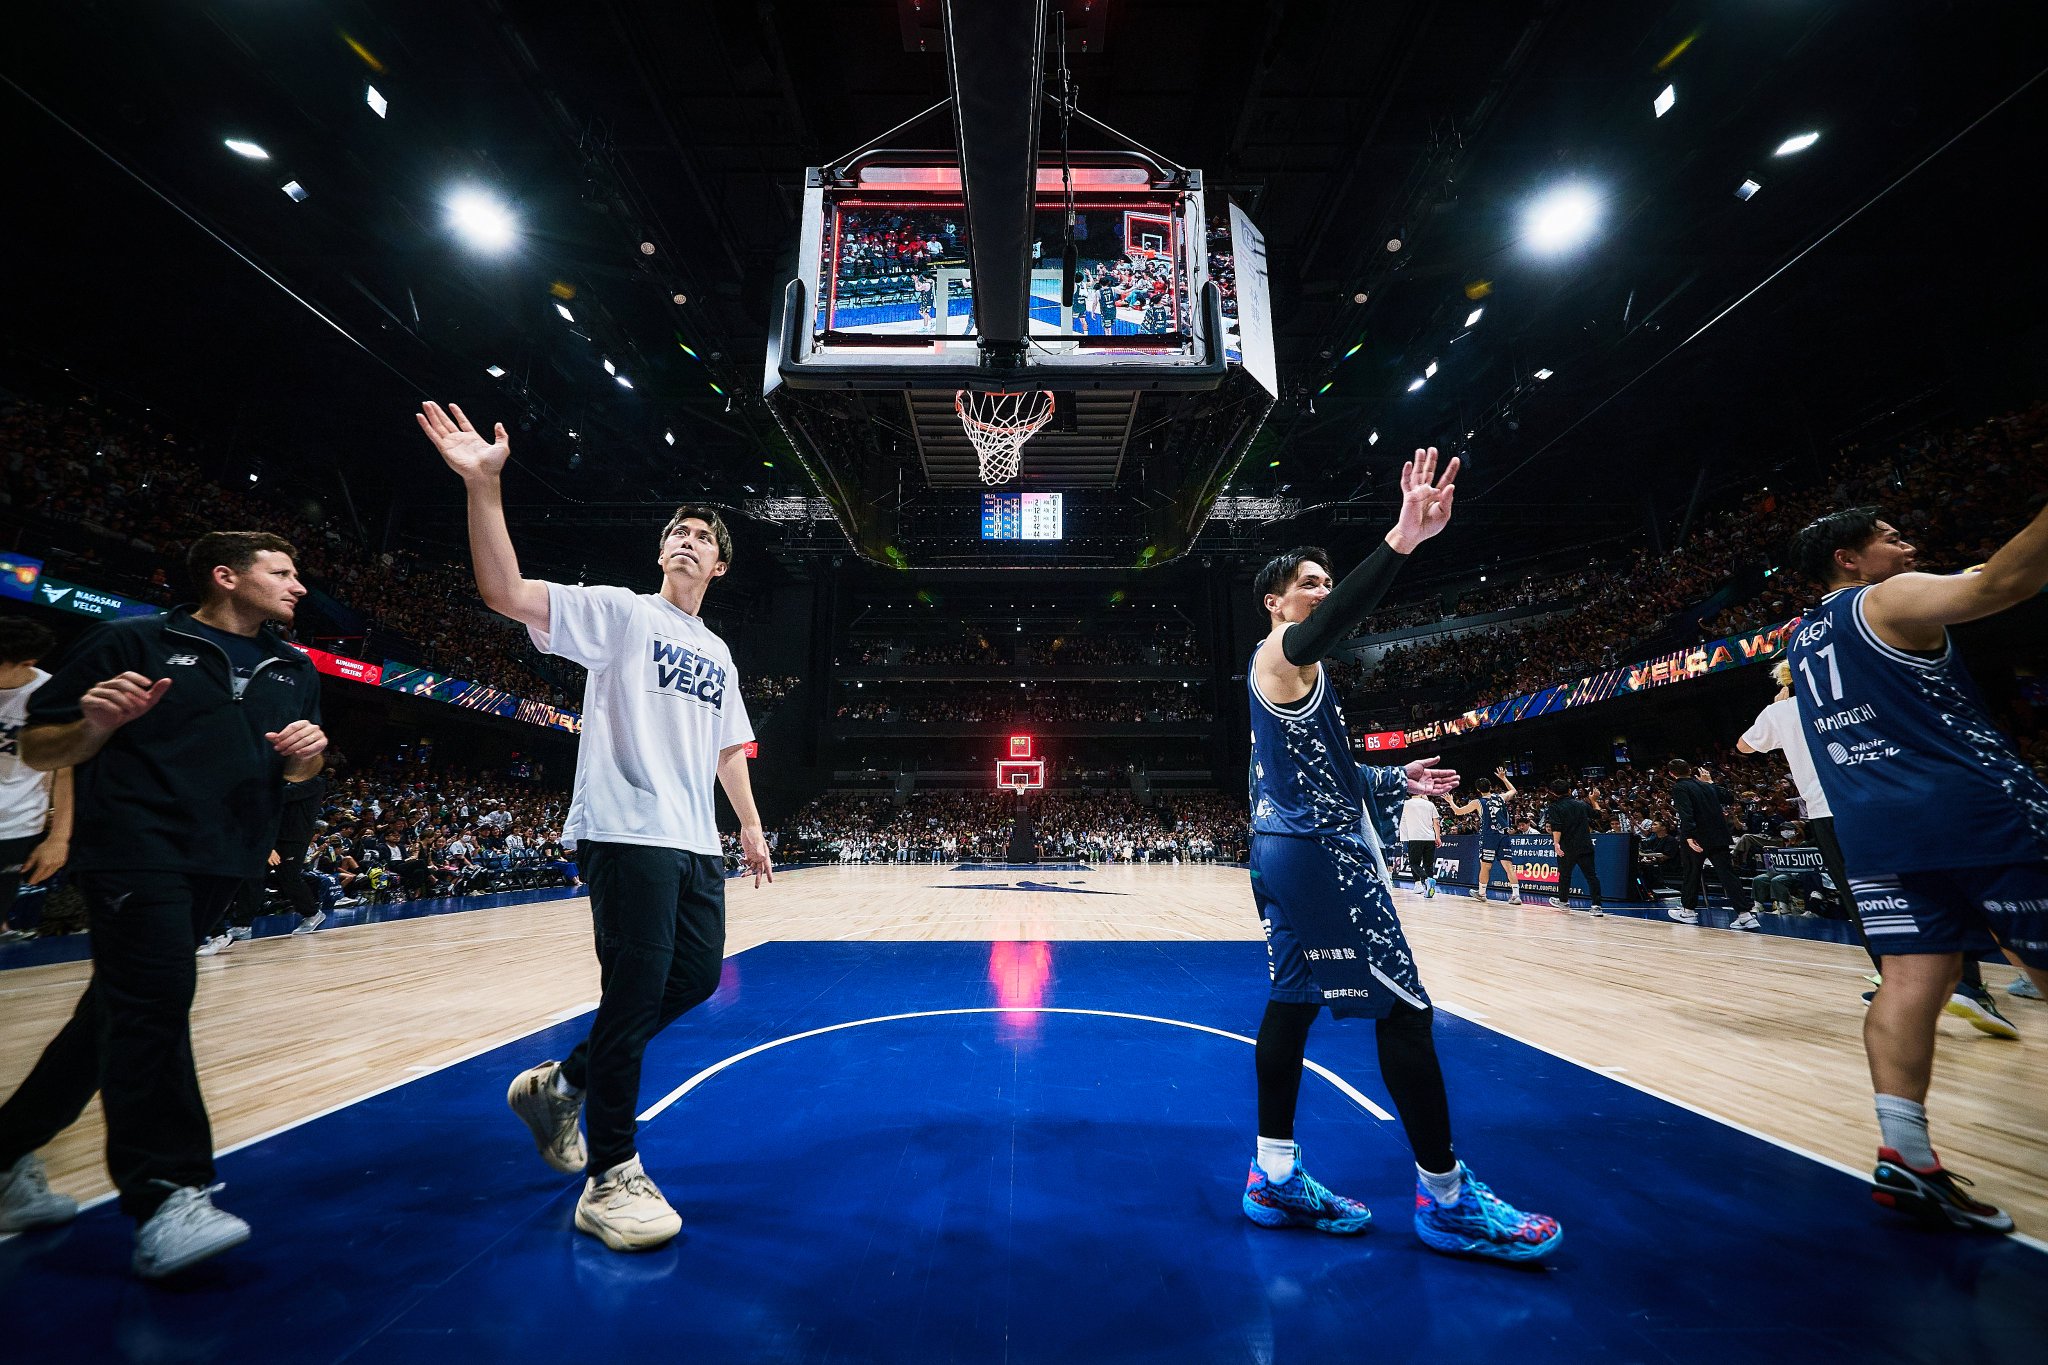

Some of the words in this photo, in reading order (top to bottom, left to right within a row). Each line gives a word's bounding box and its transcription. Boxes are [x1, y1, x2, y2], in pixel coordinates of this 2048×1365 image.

[73, 600, 102, 614] VELCA
[75, 591, 122, 609] NAGASAKI
[1631, 647, 1733, 686] VELCA
[1799, 643, 1843, 707] 17
[1367, 736, 1380, 749] 65
[1404, 724, 1443, 744] VELCA
[1846, 747, 1900, 765] エリエール
[1308, 948, 1357, 961] 谷川建設
[1323, 988, 1369, 999] 西日本ENG
